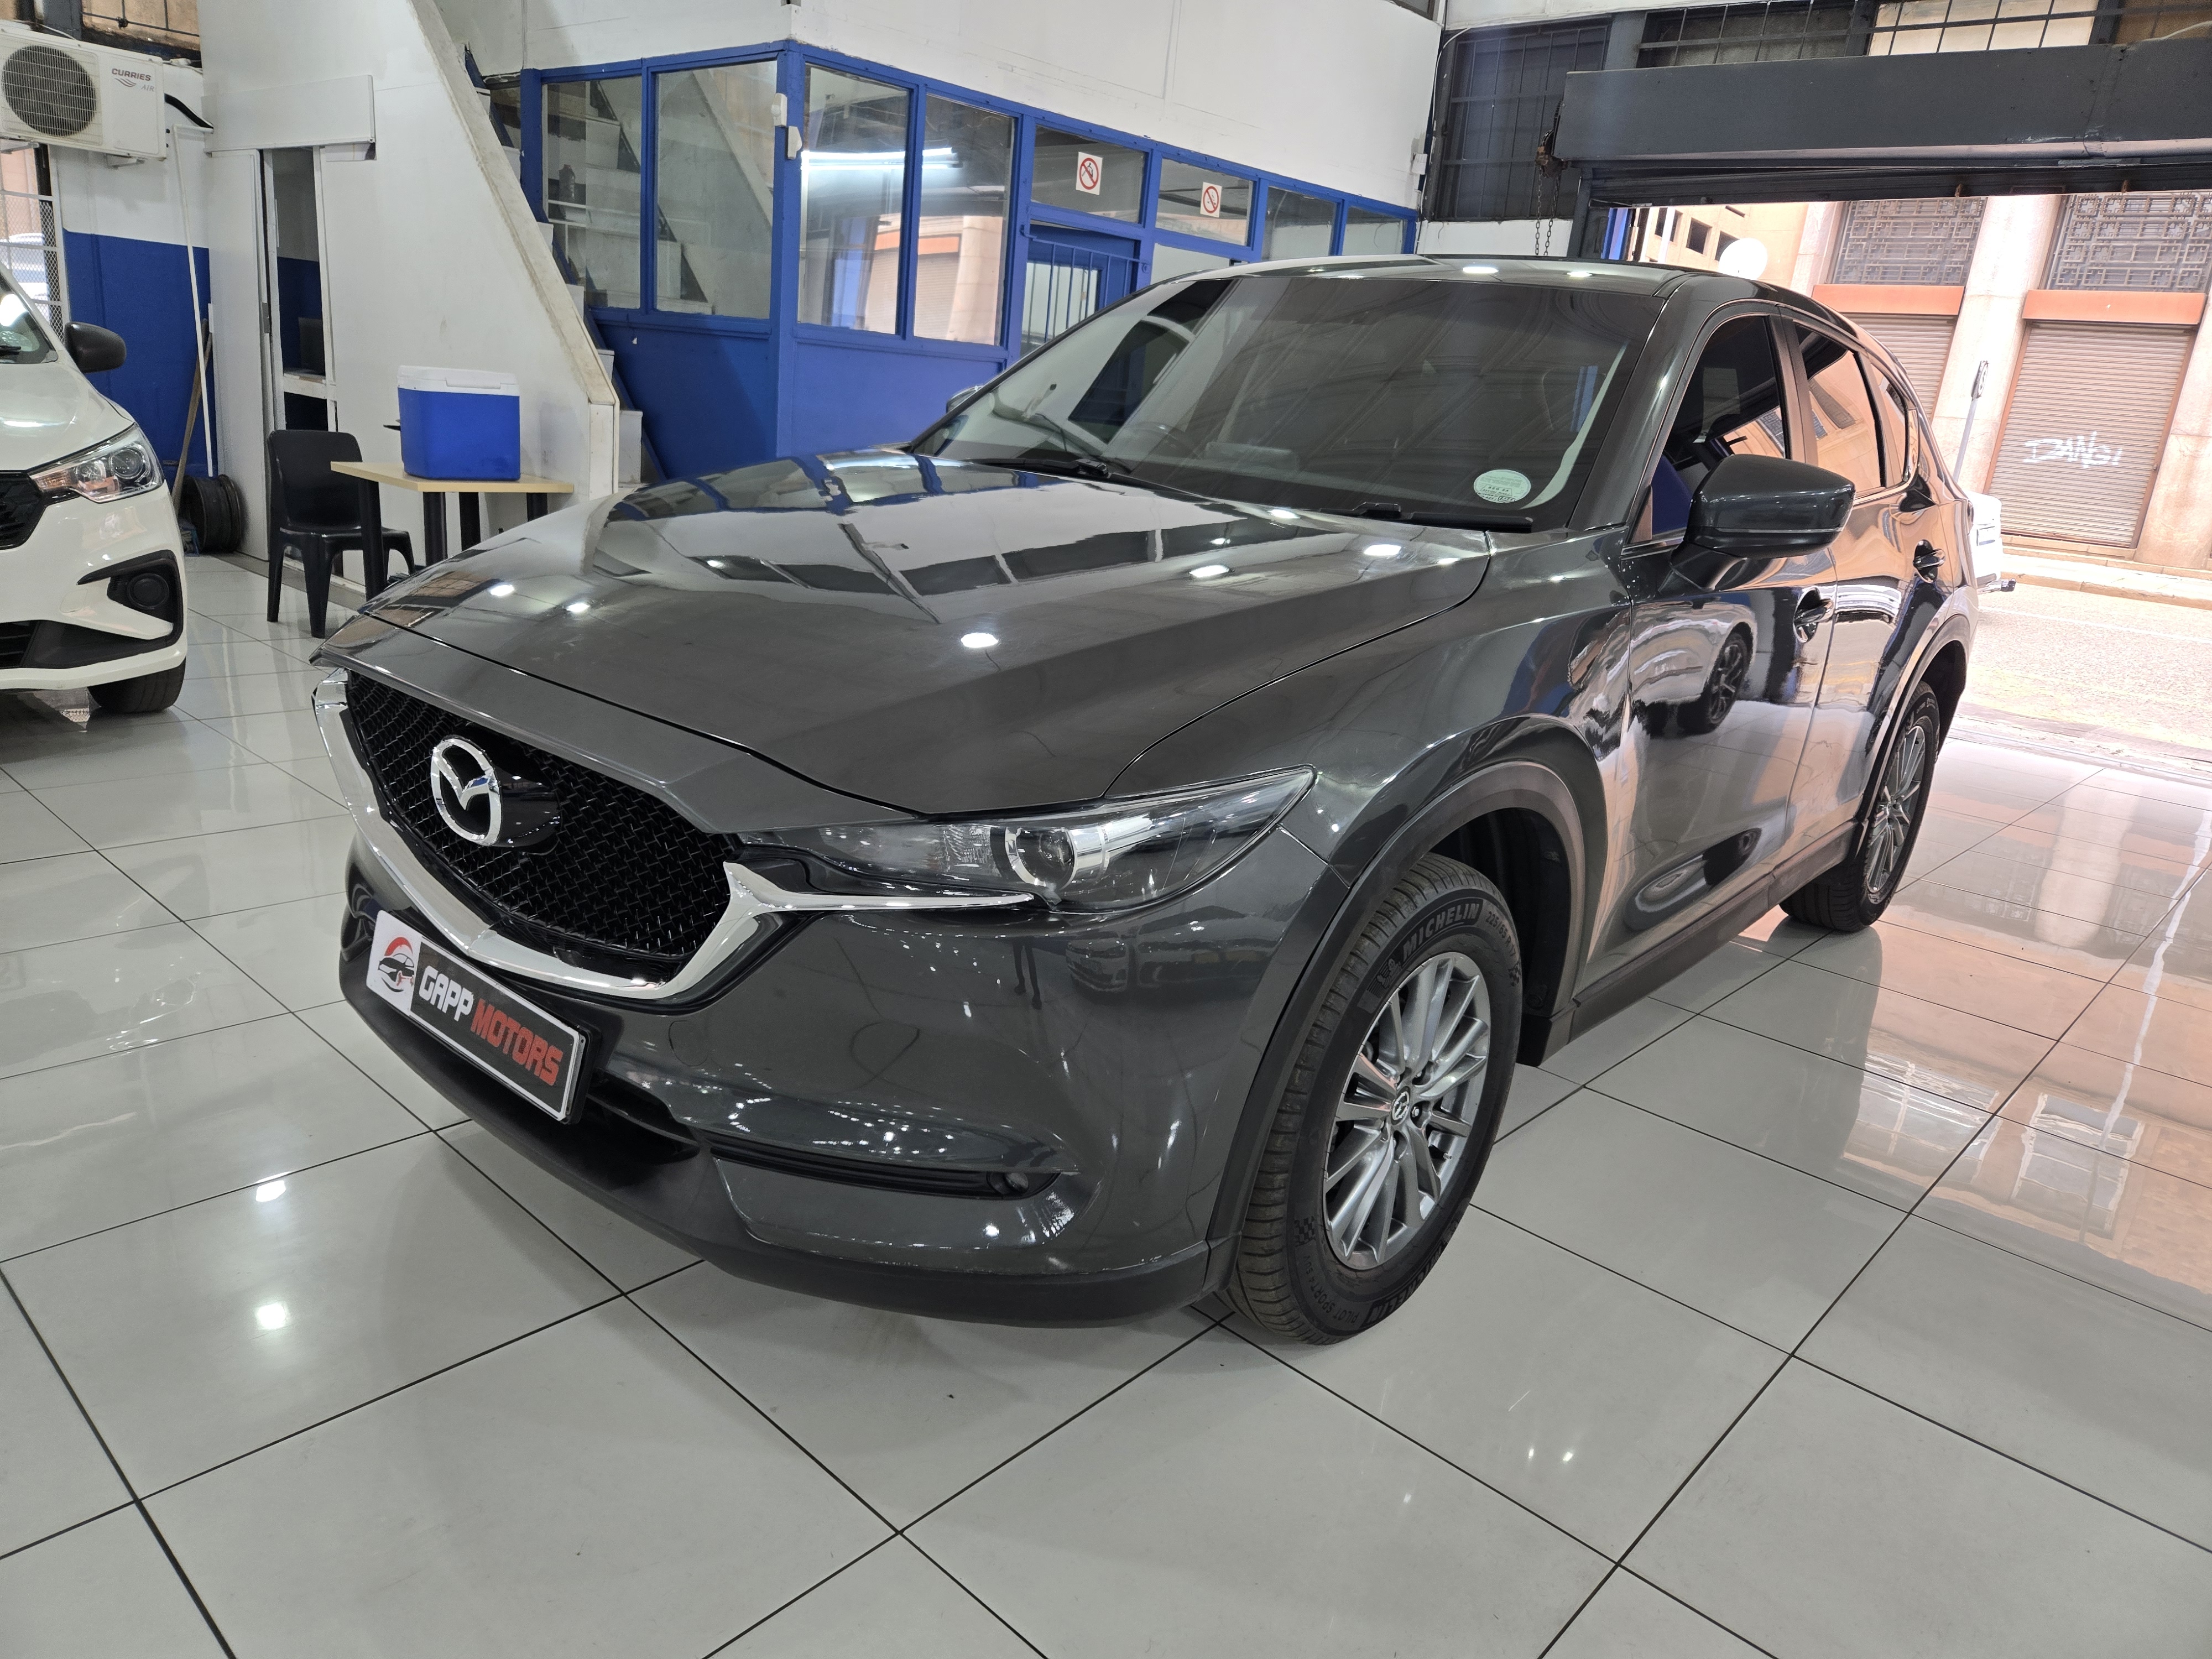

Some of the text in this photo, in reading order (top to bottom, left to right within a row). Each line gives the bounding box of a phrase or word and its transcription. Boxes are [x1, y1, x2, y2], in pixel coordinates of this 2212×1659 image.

[112, 69, 152, 81] CURRIES
[1403, 903, 1480, 962] MICHELIN
[1485, 911, 1508, 938] 225/65
[419, 966, 564, 1086] GAPP MOTORS
[1310, 1282, 1335, 1314] SPORT
[1333, 1307, 1360, 1323] PILOT
